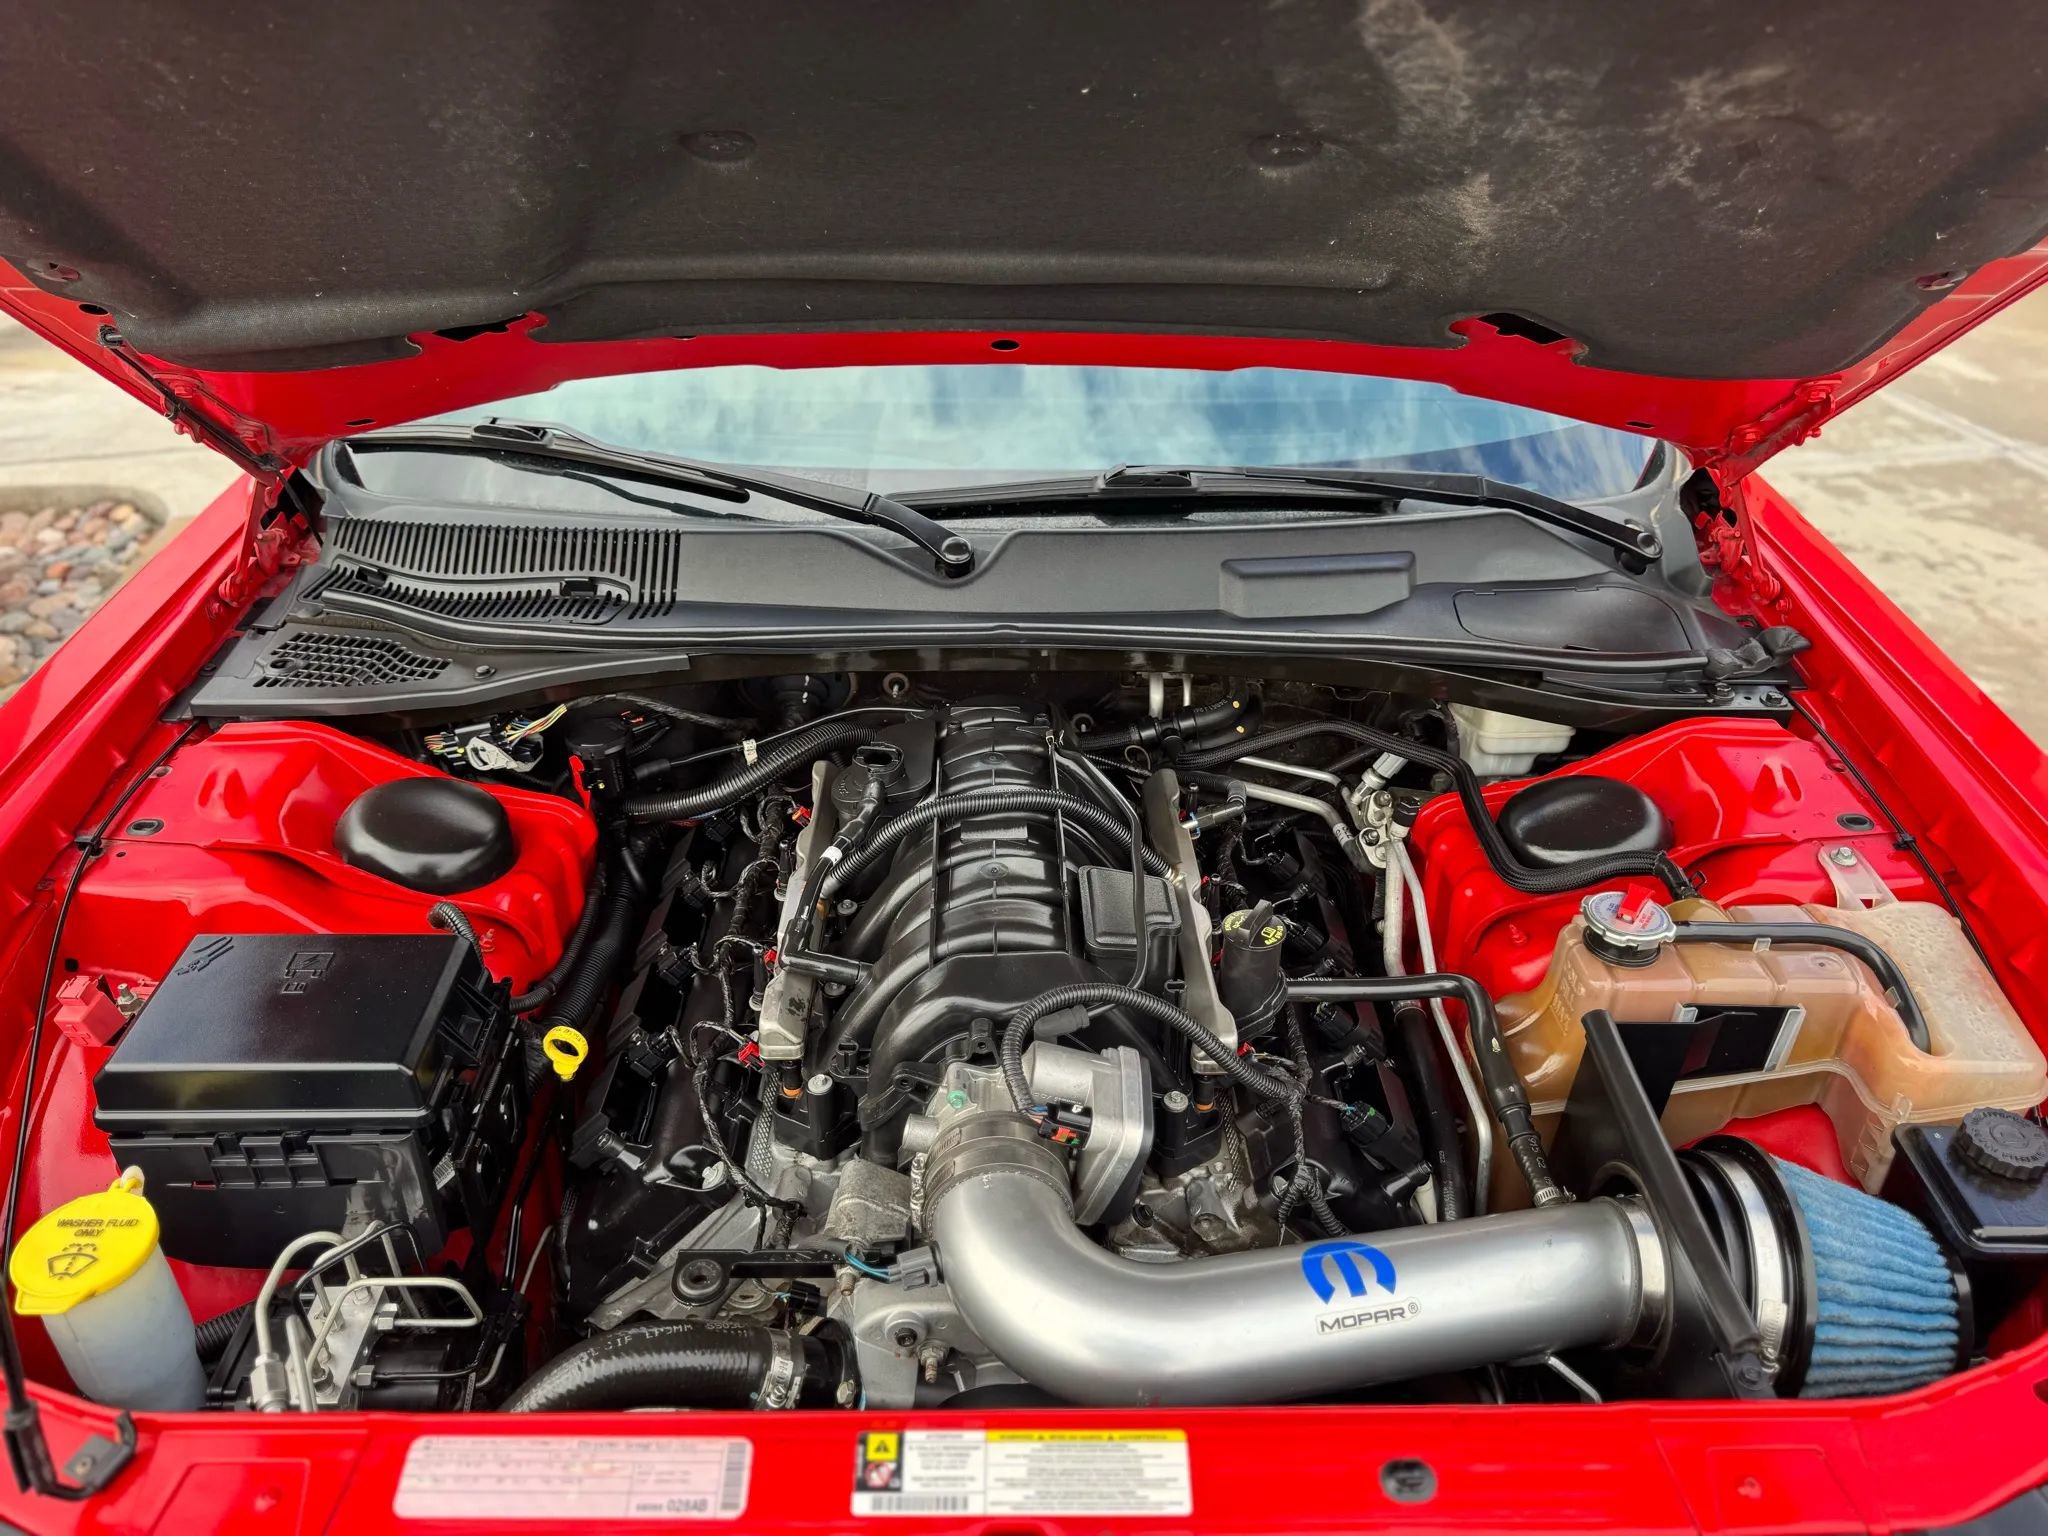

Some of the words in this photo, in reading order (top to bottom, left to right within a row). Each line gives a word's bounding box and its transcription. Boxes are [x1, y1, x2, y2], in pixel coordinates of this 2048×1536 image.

[57, 1218, 105, 1228] WASHER
[106, 1218, 140, 1227] FLUID
[74, 1228, 105, 1238] ONLY
